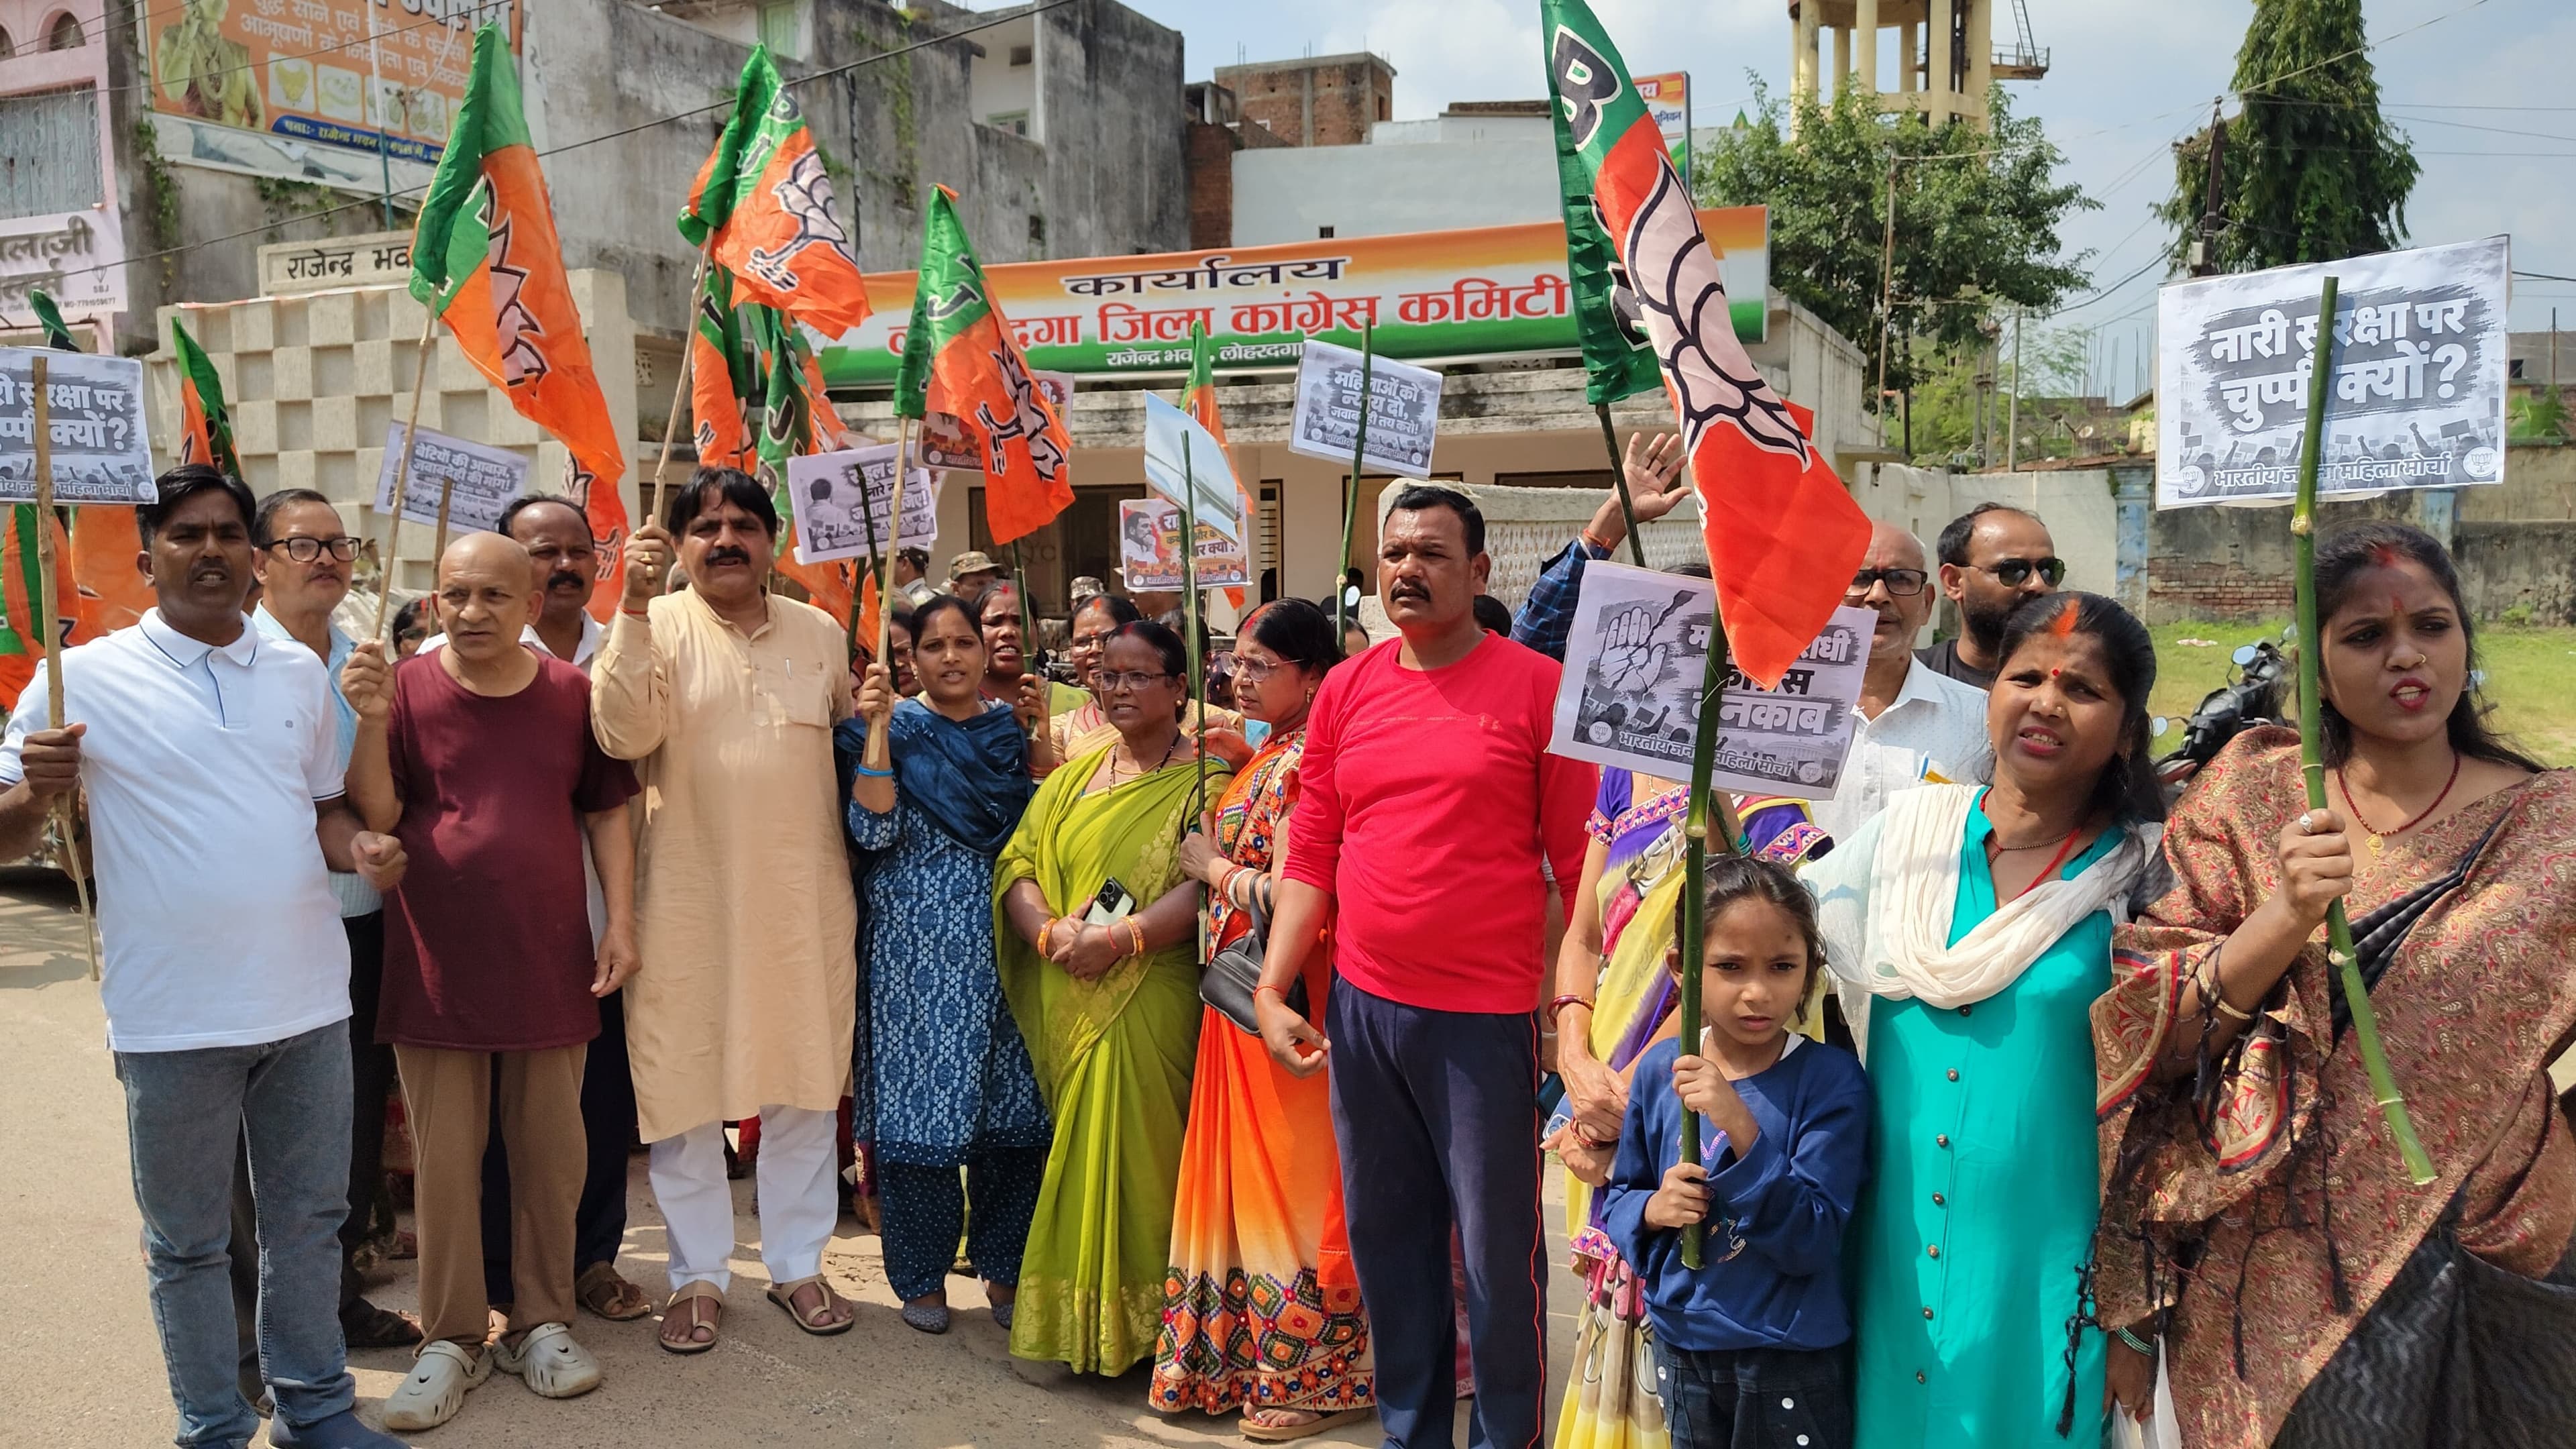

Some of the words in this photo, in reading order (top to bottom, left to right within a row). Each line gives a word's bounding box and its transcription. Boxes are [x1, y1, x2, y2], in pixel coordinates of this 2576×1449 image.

[287, 249, 355, 280] राजेन्द्र
[372, 246, 411, 270] भव
[1067, 258, 1347, 297] कार्यालय
[1230, 291, 1382, 335] कांग्रेस
[1397, 272, 1572, 325] कमिटी
[2209, 309, 2290, 364] नारी
[2415, 297, 2471, 337] पर
[94, 388, 127, 412] पर
[1399, 382, 1419, 402] को
[2219, 356, 2314, 433] चुप्पी
[2214, 463, 2280, 488] भारतीय
[2339, 456, 2401, 481] महिला
[2402, 452, 2451, 476] मोर्चा
[1619, 732, 1669, 755] भारतीय
[1756, 755, 1794, 777] मोर्चा
